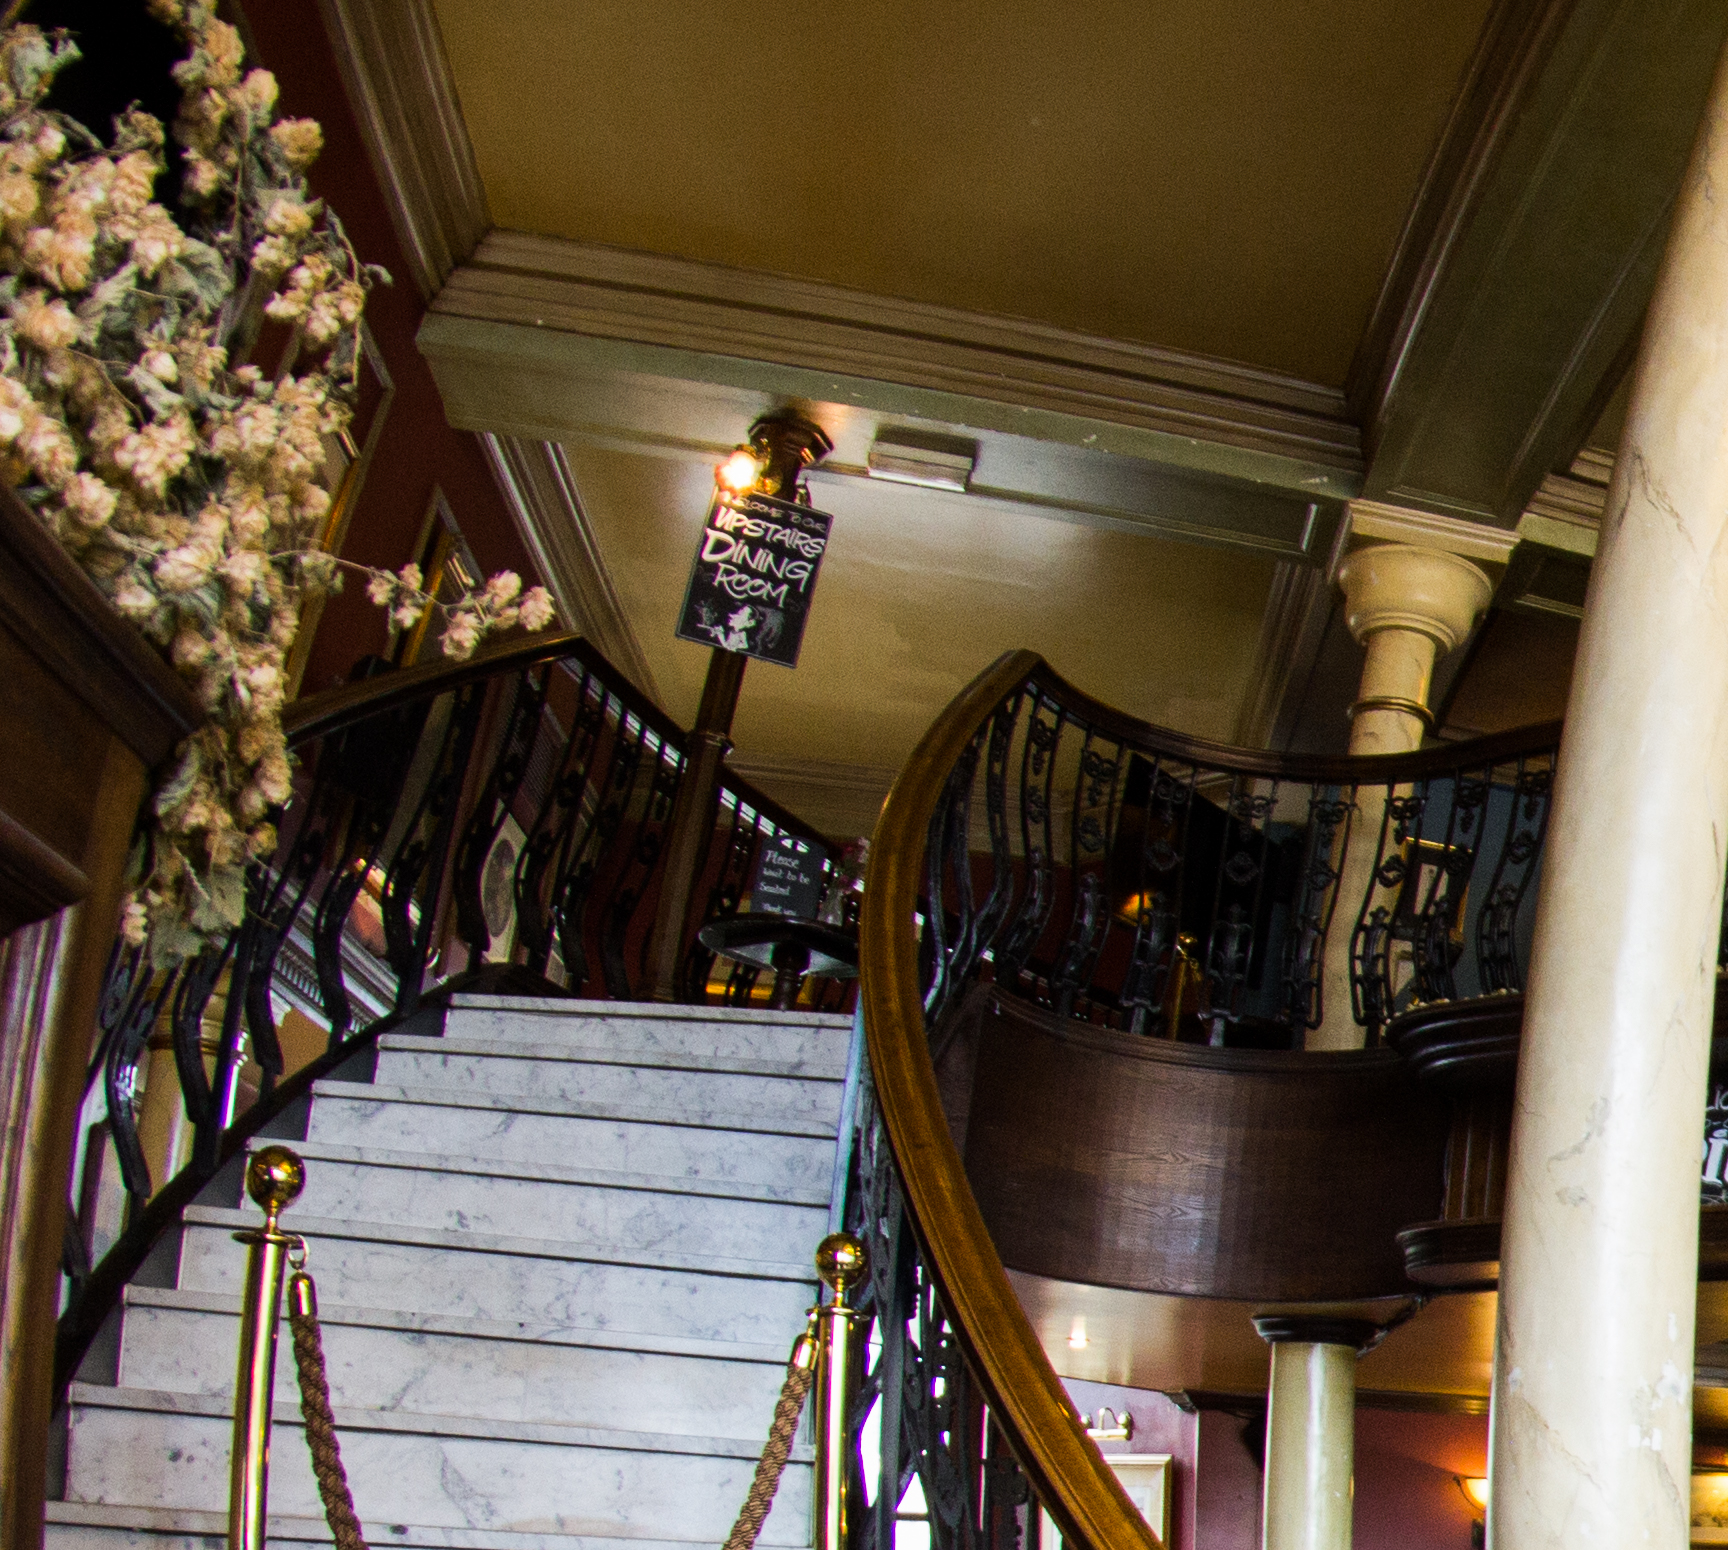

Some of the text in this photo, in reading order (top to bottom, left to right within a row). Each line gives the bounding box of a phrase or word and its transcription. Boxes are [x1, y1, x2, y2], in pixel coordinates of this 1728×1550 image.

[715, 505, 826, 558] UPSTAIRS
[713, 562, 789, 608] ROOM
[765, 850, 800, 869] Please
